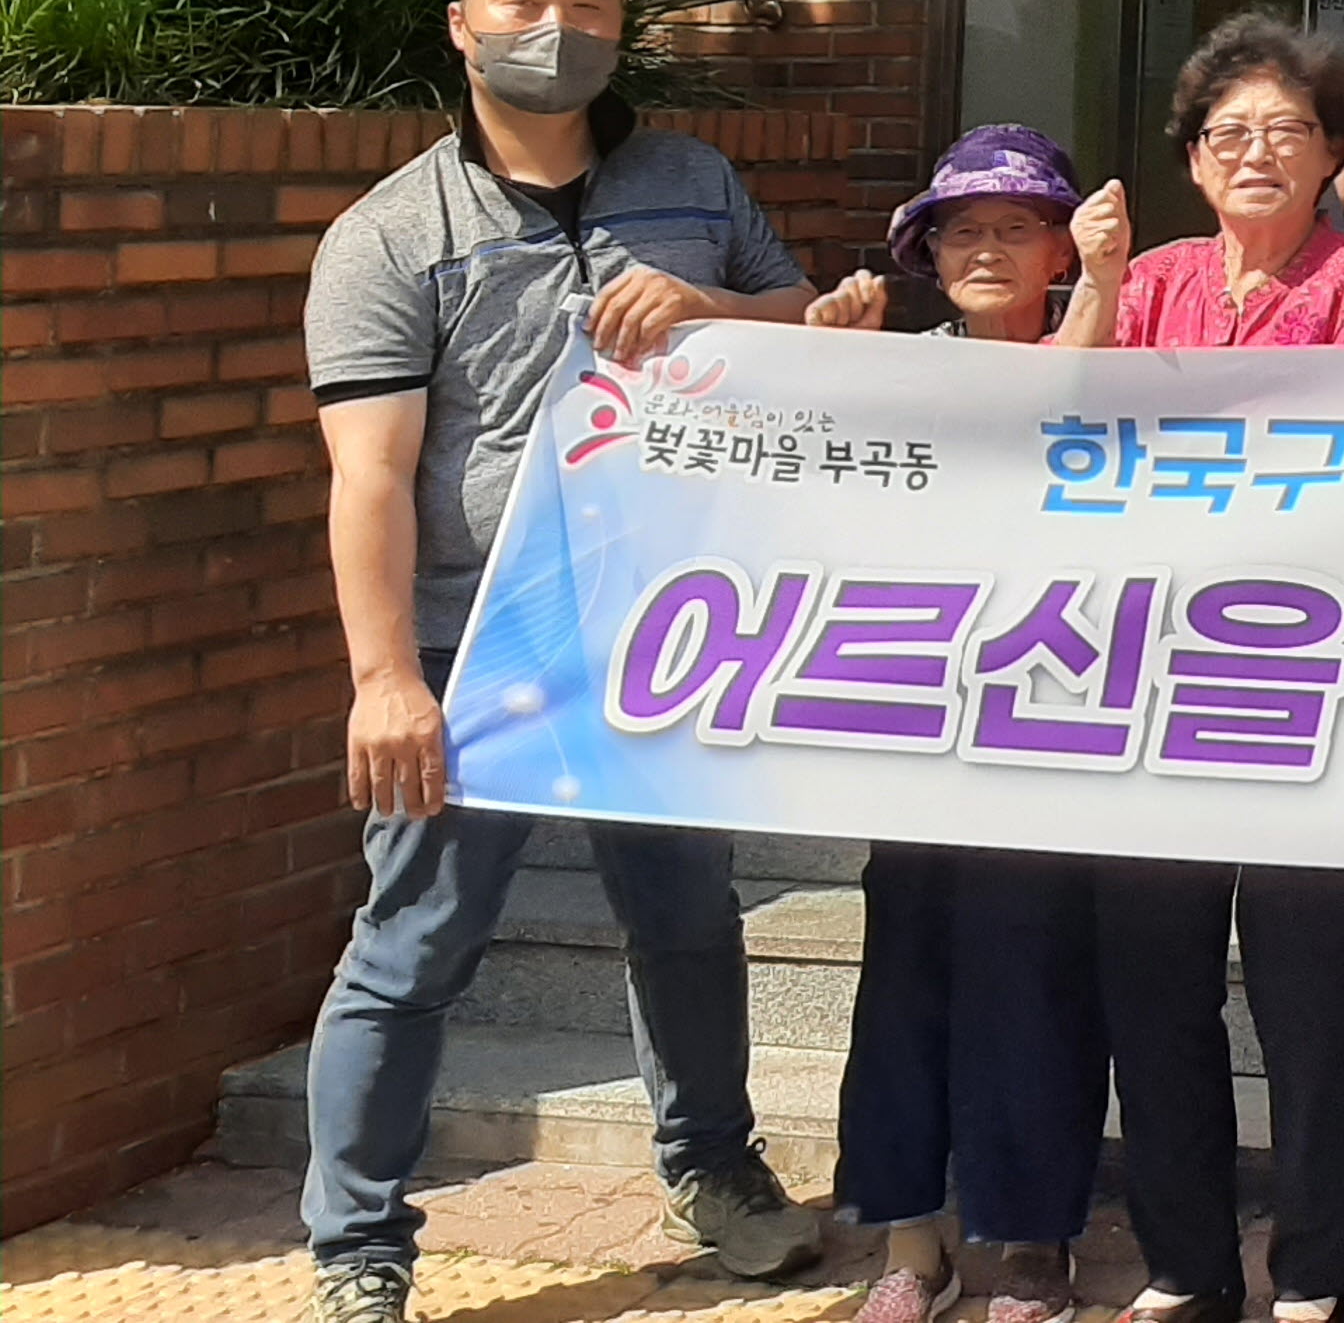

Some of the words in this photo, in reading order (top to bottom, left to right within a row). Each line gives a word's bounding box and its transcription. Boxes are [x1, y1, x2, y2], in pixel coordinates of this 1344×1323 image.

[643, 420, 806, 483] 벚꽃마을
[819, 439, 939, 492] 부곡동
[617, 568, 1343, 768] 어르신을
